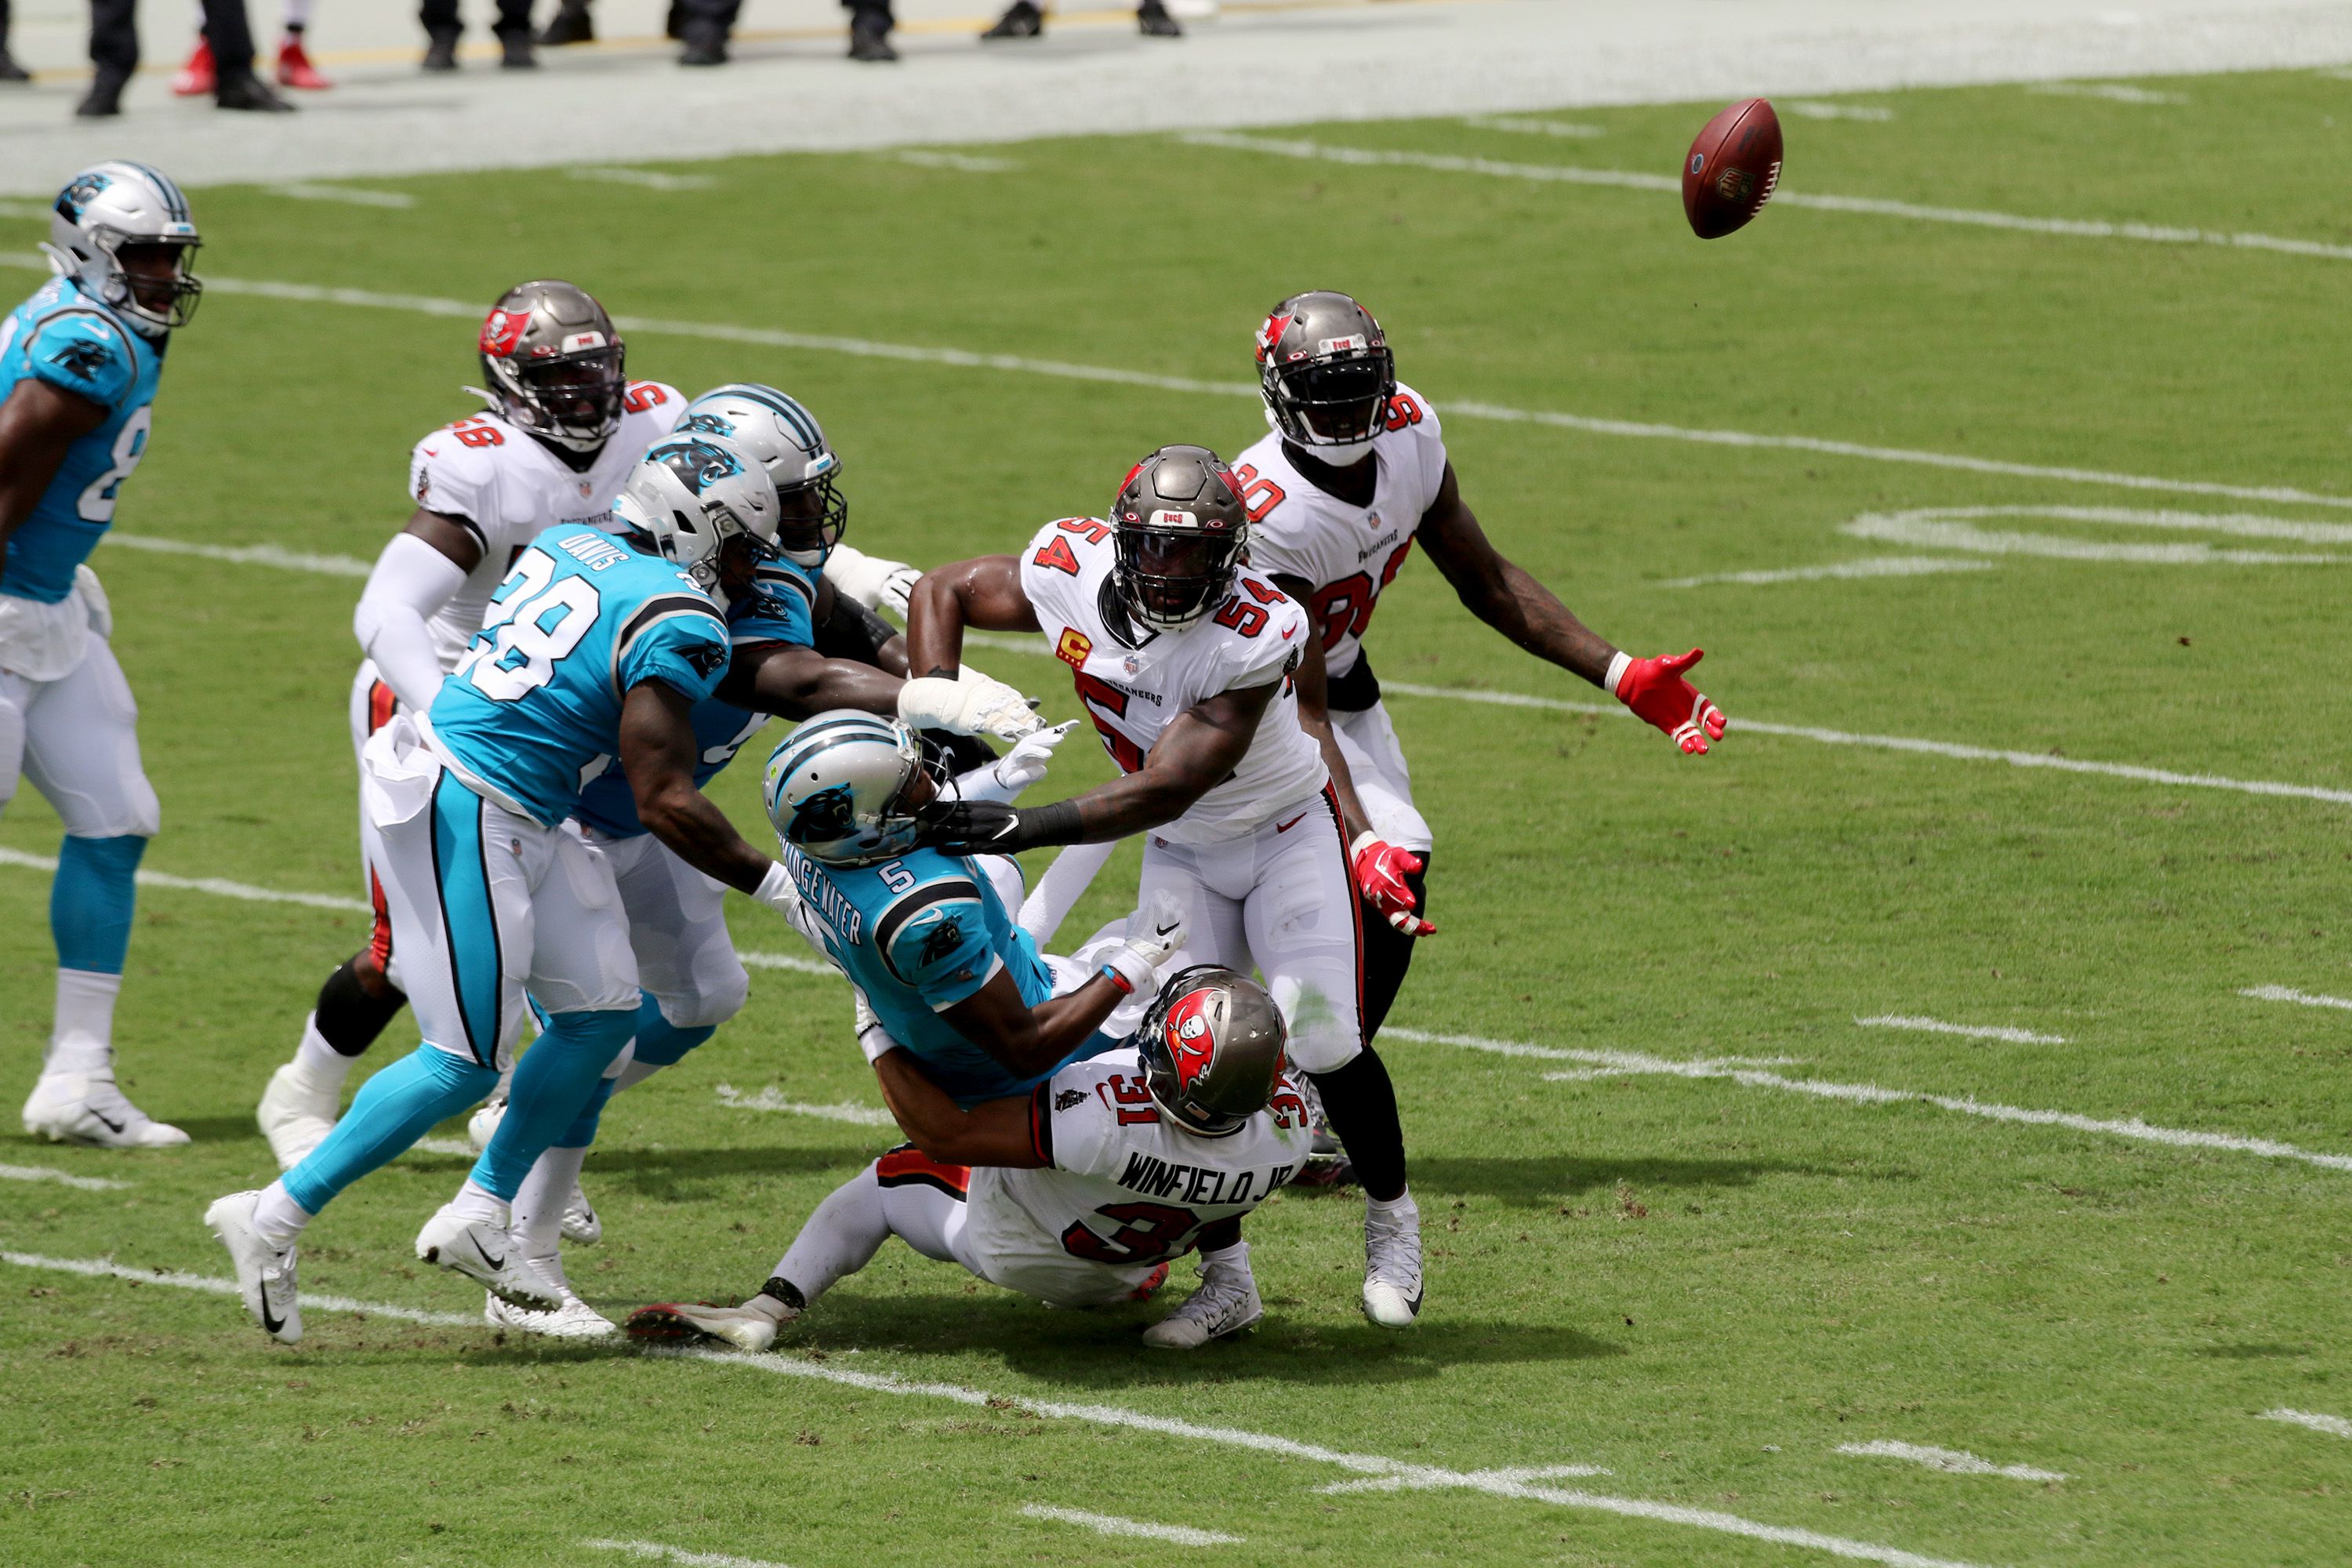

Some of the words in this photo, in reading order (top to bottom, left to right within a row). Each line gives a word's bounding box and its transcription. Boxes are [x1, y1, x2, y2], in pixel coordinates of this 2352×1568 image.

[1720, 171, 1742, 196] NFL
[623, 380, 668, 415] 5
[1383, 394, 1423, 432] 9
[557, 532, 630, 572] DAVIS
[1033, 515, 1111, 577] 54
[1212, 577, 1288, 638] 54
[1060, 629, 1092, 660] C
[1073, 666, 1145, 775] 5
[777, 831, 862, 946] IDGEWATER
[877, 861, 916, 895] 5
[1107, 1073, 1161, 1127] 31
[1117, 1151, 1254, 1205] WINFIELD
